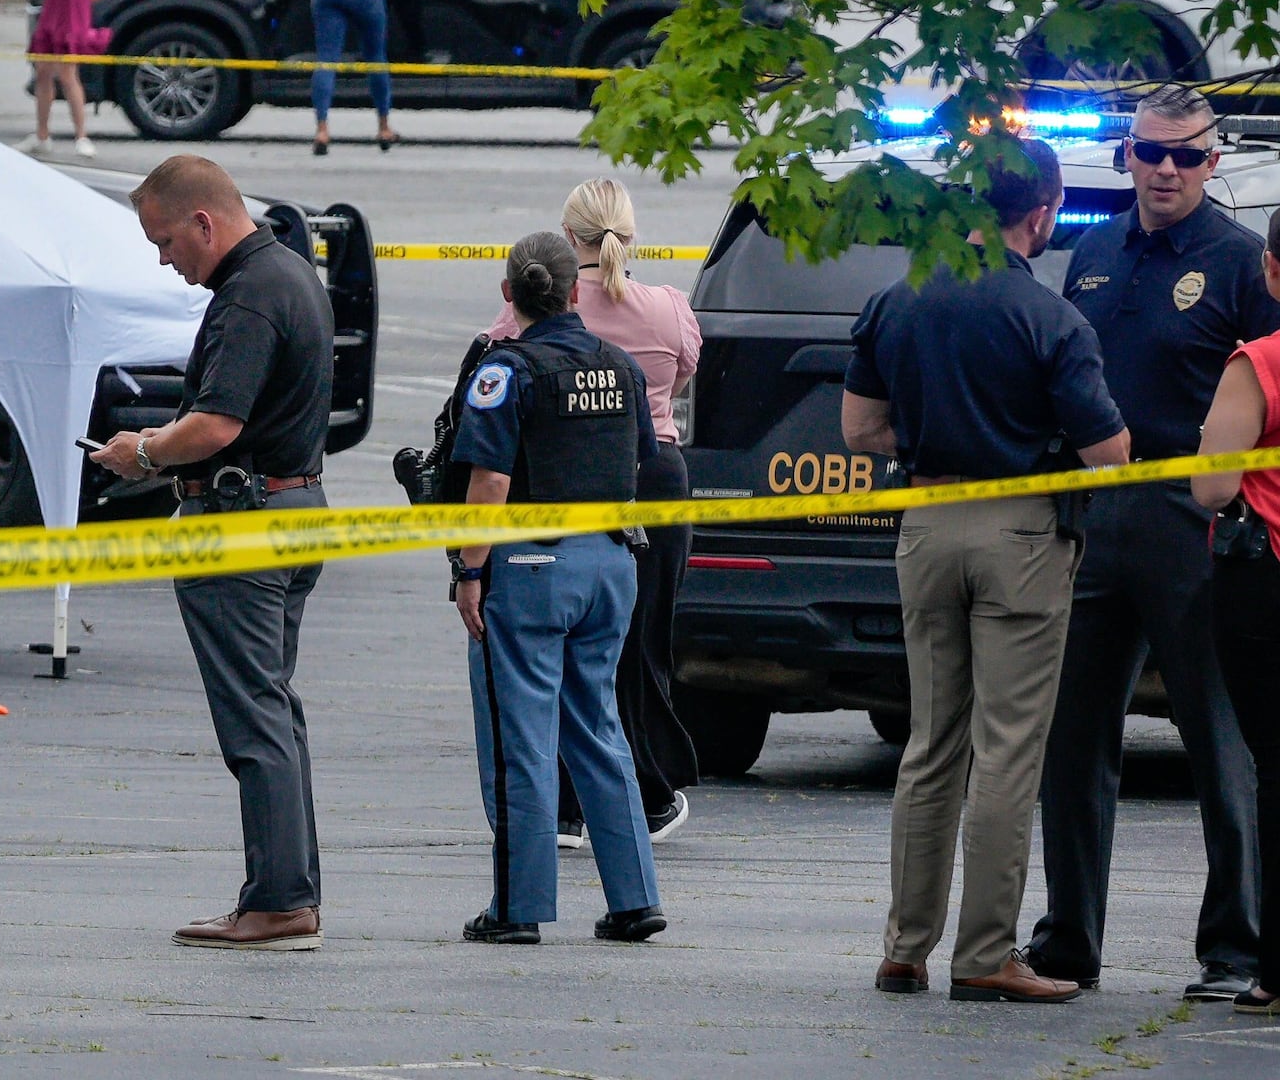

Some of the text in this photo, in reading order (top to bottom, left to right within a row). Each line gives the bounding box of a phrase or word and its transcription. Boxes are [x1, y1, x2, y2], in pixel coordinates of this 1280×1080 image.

[375, 245, 406, 259] CRI
[439, 245, 495, 259] CROSS
[575, 369, 617, 390] COBB
[567, 390, 624, 412] POLICE
[768, 451, 874, 495] COBB
[807, 513, 895, 528] Commitment
